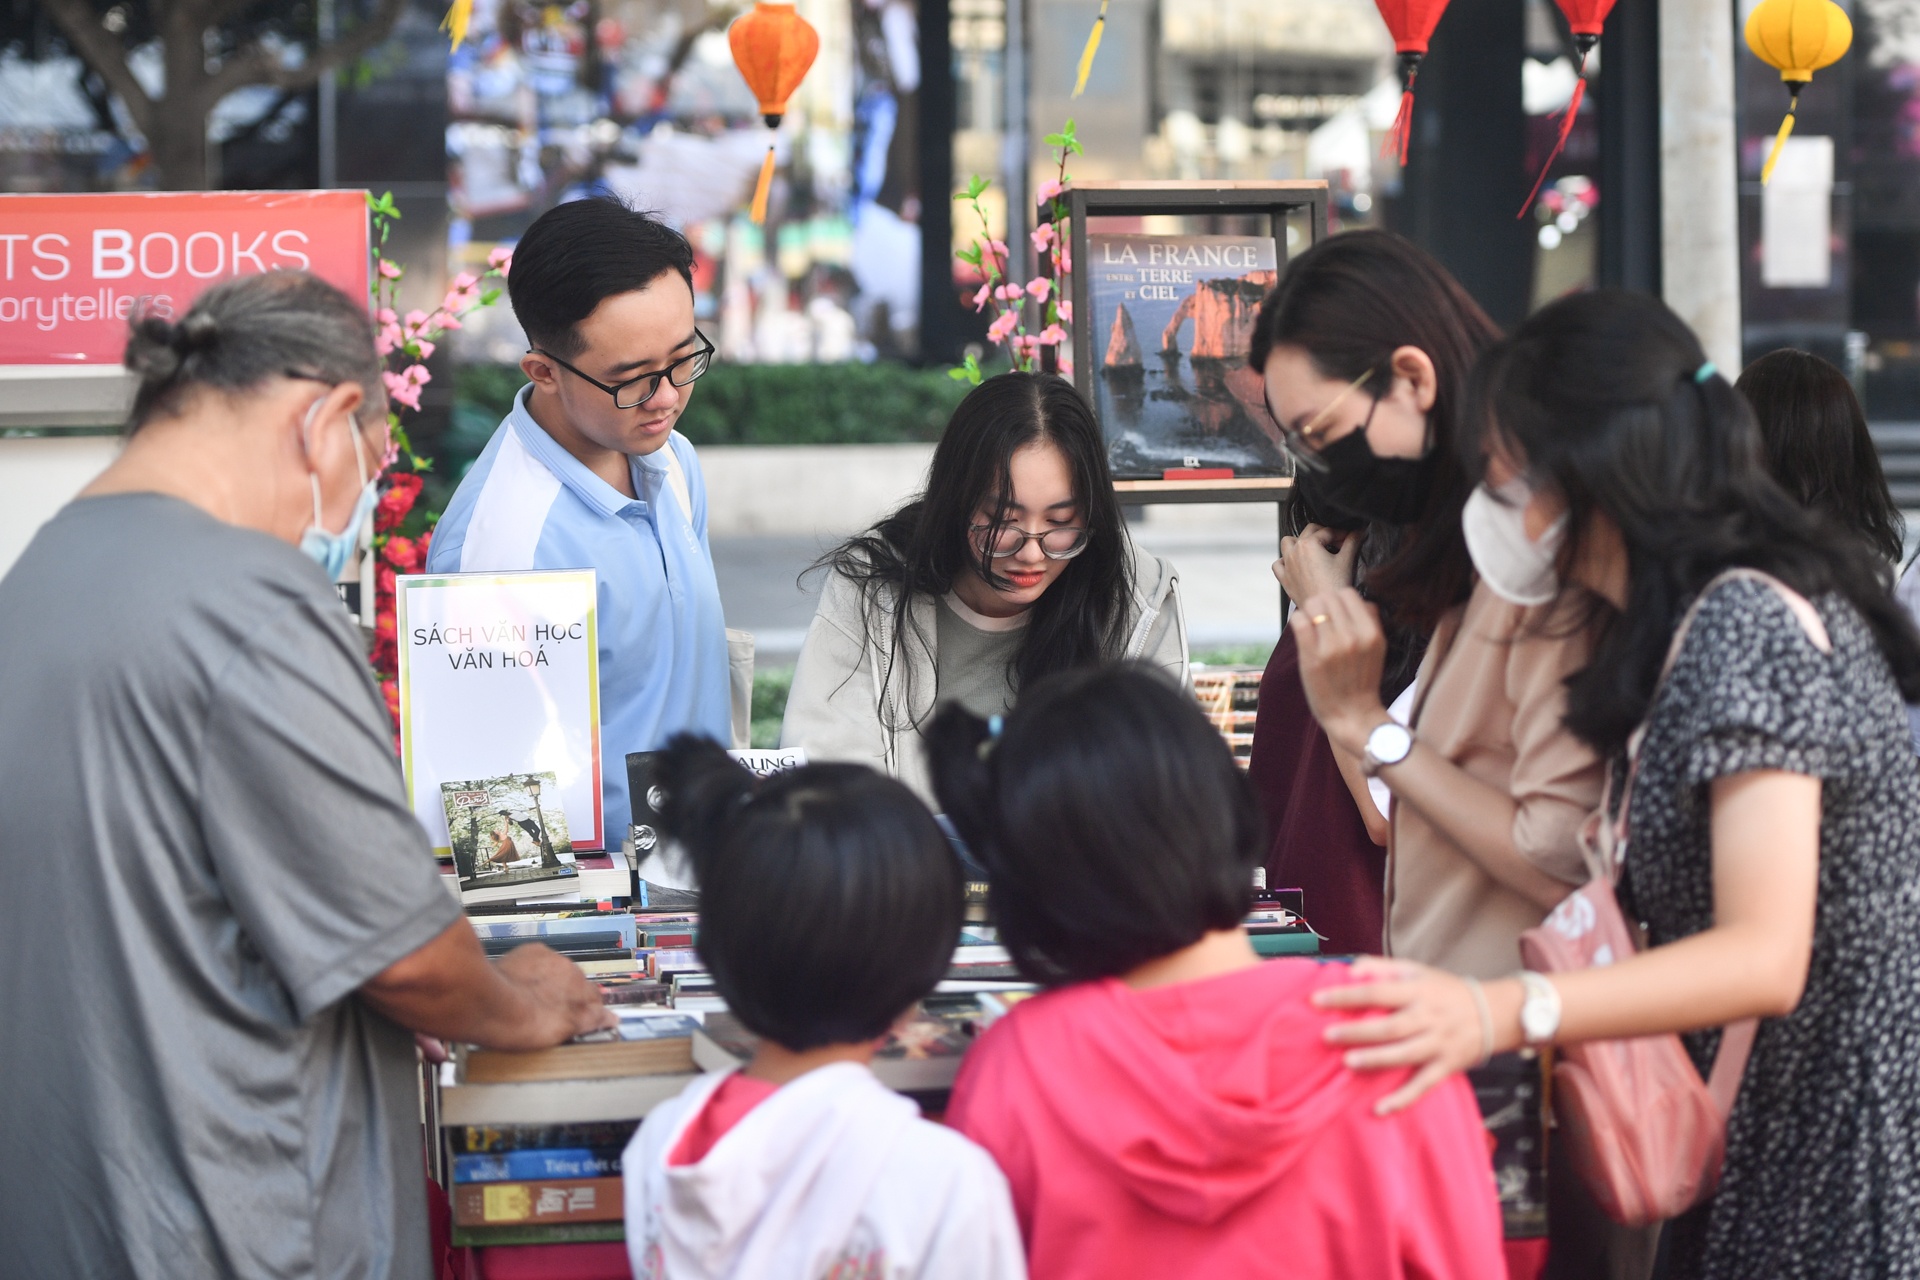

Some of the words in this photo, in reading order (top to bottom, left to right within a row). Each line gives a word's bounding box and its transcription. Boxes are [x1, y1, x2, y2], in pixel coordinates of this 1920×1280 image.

[92, 228, 310, 280] BOOKS
[1103, 243, 1138, 265] LA
[1149, 244, 1258, 268] FRANCE
[1137, 268, 1193, 284] TERRE
[1139, 284, 1179, 300] CIEL
[413, 622, 473, 646] SÁCH
[481, 620, 526, 644] VĂN
[535, 622, 582, 645] HỌC
[448, 647, 493, 670] VĂN
[503, 645, 549, 668] HOÁ
[737, 755, 796, 770] AUNG
